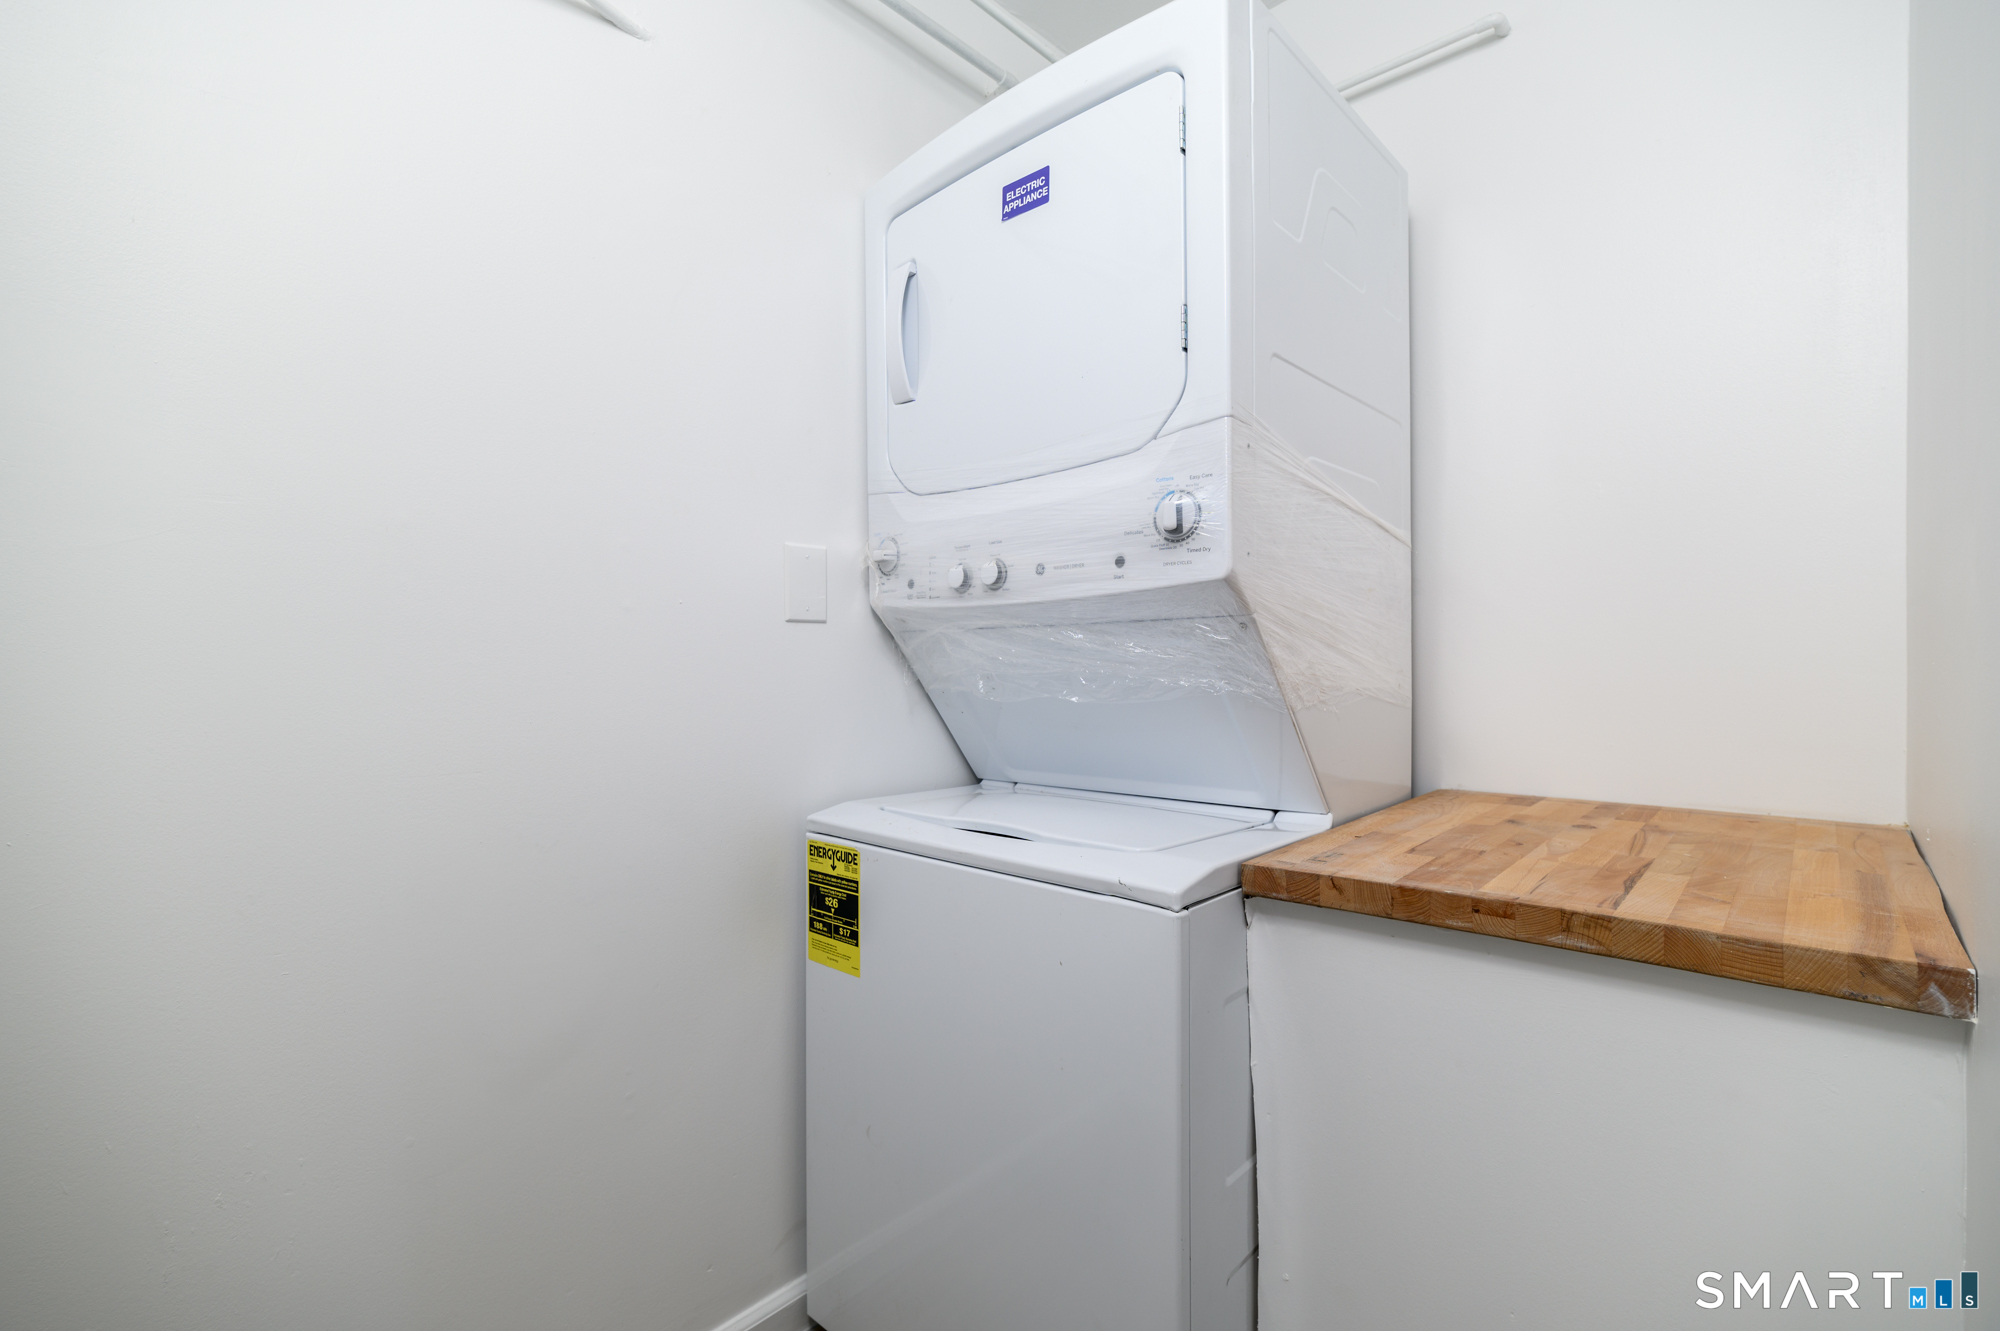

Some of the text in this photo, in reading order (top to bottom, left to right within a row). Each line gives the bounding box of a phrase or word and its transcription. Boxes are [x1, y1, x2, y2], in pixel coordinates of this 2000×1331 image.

[1006, 176, 1046, 202] ELECTRIC
[1003, 186, 1049, 215] APPLIANCE
[809, 844, 858, 866] ENERGYGUIDE
[824, 896, 839, 909] $26
[839, 927, 851, 937] $17
